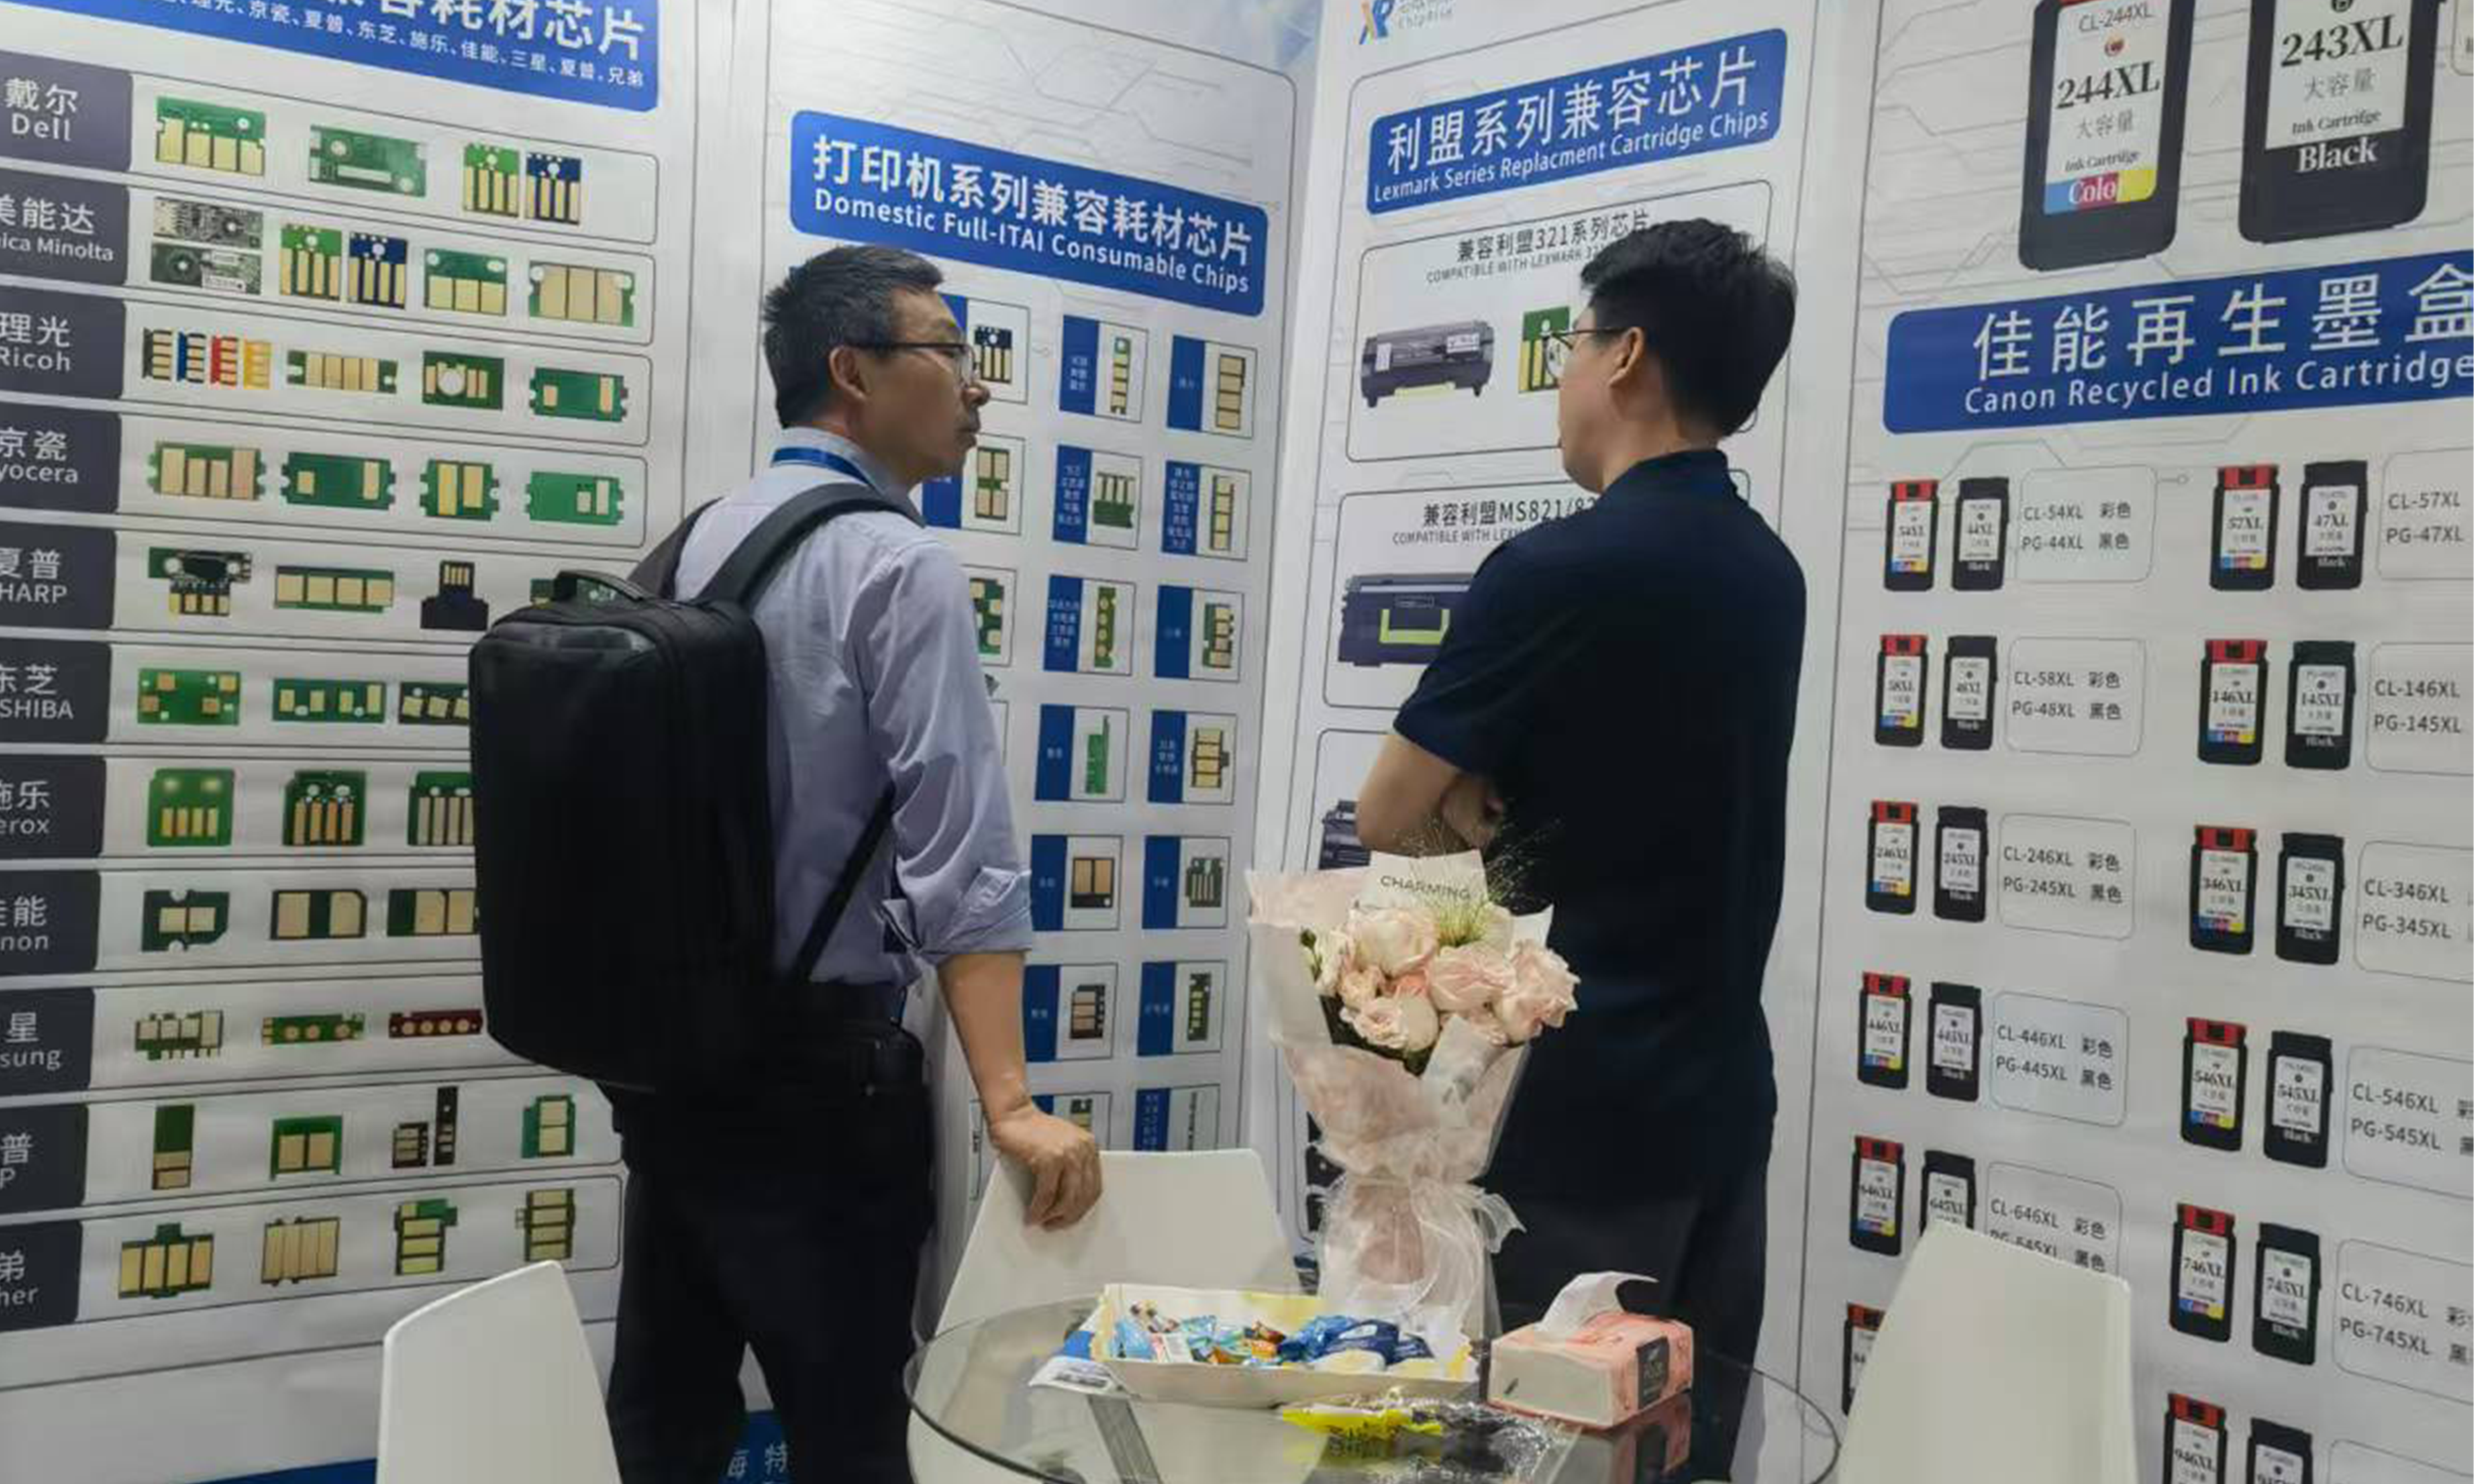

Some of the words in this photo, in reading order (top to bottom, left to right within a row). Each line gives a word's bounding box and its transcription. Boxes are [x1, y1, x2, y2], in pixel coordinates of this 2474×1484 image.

[328, 0, 644, 61] 耗材芯片
[2079, 3, 2155, 32] CL-244XL
[2281, 14, 2403, 67] 243XL
[5, 77, 78, 115] 戴尔
[2056, 60, 2160, 110] 244XL
[2304, 67, 2375, 102] 大容量
[1388, 46, 1756, 174] 利盟系列兼容芯片
[2076, 109, 2133, 139] 大容量
[12, 113, 71, 141] Dell
[2292, 120, 2314, 134] Ink
[1374, 170, 1439, 203] Lexmark
[1444, 162, 1495, 188] Series
[1500, 143, 1606, 178] Replacment
[1611, 120, 1704, 157] Cartridge
[1710, 110, 1769, 140] Chips
[2065, 157, 2085, 172] Ink
[2297, 136, 2379, 174] Black
[0, 194, 95, 234] 美能达
[813, 134, 1252, 266] 打印机系列兼容耗材芯片
[0, 234, 31, 251] ica
[37, 236, 114, 263] Minolta
[815, 187, 935, 232] Domestic
[1052, 232, 1187, 281] Consumable
[1192, 262, 1250, 294] Chips
[1457, 209, 1649, 263] 兼容利盟321系列芯片
[1426, 261, 1493, 284] COMPATIBLE
[1498, 259, 1526, 274] WITH
[1531, 248, 1582, 267] LEXMARK
[0, 312, 71, 348] 理光
[1973, 264, 2474, 380] 佳能再生墨盒
[0, 345, 71, 372] Ricoh
[1964, 386, 2055, 415] Canon
[2068, 368, 2214, 410] Recycled
[2227, 364, 2281, 395] Ink
[2295, 350, 2474, 392] Cartridge
[0, 426, 67, 462] 京瓷
[2024, 506, 2084, 521] CL-54XL
[2099, 502, 2131, 519] 彩色
[2387, 491, 2461, 510] CL-57XL
[1392, 531, 1458, 545] COMPATIBLE
[1462, 528, 1490, 542] WITH
[2022, 535, 2084, 551] PG-44XL
[2098, 533, 2130, 550] 黑色
[2386, 526, 2465, 544] PG-47XL
[0, 547, 61, 580] 夏普
[0, 664, 58, 695] 东芝
[2013, 671, 2074, 687] CL-58XL
[2088, 672, 2121, 689] 彩色
[2374, 679, 2460, 699] CL-146XL
[0, 699, 74, 720] SHIBA
[2088, 703, 2122, 721] 黑色
[2374, 714, 2461, 734] PG-145XL
[2004, 846, 2074, 867] CL-246XL
[2088, 852, 2121, 872] 彩色
[1380, 875, 1471, 901] CHARMING
[2004, 876, 2076, 898] PG-245XL
[2089, 884, 2122, 904] 黑色
[2364, 879, 2450, 904] CL-346XL
[2363, 914, 2452, 939] PG-345XL
[6, 1012, 39, 1044] 星
[1997, 1024, 2067, 1050] CL-446XL
[2081, 1037, 2114, 1059] 彩色
[1996, 1055, 2068, 1081] PG-445XL
[2080, 1069, 2112, 1090] 黑色
[2352, 1083, 2439, 1114] CL-546XL
[1, 1133, 31, 1164] 普
[2351, 1118, 2441, 1150] PG-545XL
[1990, 1198, 2060, 1229] CL-646XL
[2073, 1217, 2106, 1240] 彩色
[2074, 1249, 2106, 1273] 黑色
[2183, 1257, 2226, 1279] 746XL
[2341, 1283, 2429, 1318] CL-746XL
[2340, 1317, 2430, 1355] PG-745XL
